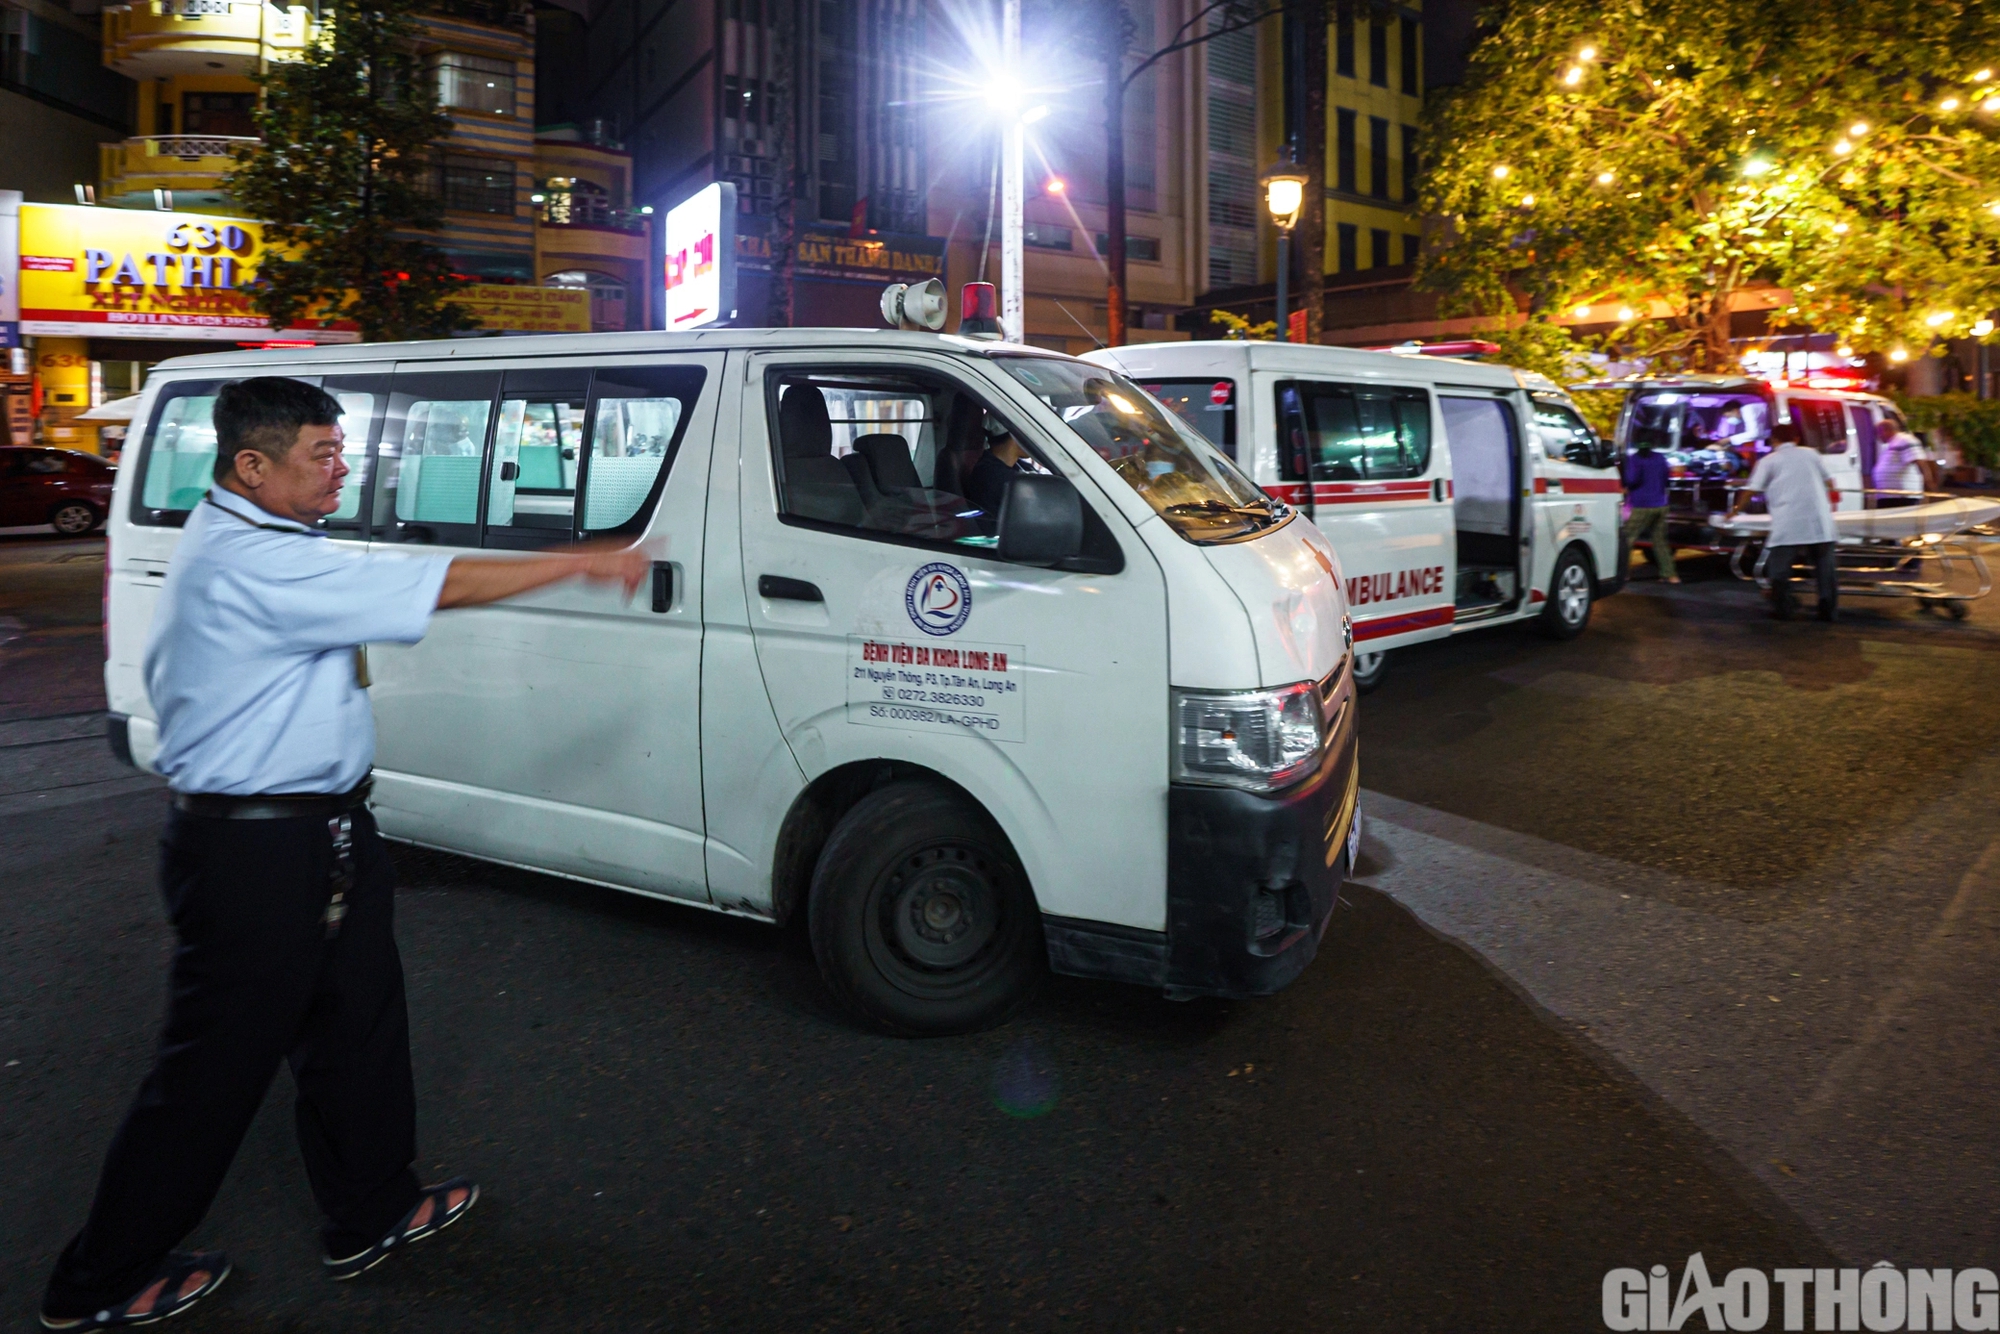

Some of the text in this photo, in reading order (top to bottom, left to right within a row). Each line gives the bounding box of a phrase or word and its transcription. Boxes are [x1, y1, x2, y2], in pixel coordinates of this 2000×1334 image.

[166, 223, 245, 250] 630
[862, 640, 889, 665] BỆNH
[891, 642, 914, 667] VIỆN
[932, 648, 960, 668] KHOA
[962, 650, 990, 671] LONG
[992, 652, 1007, 672] AN
[982, 677, 1003, 694] Long
[1005, 679, 1017, 692] An
[897, 688, 985, 707] 0272.3826330
